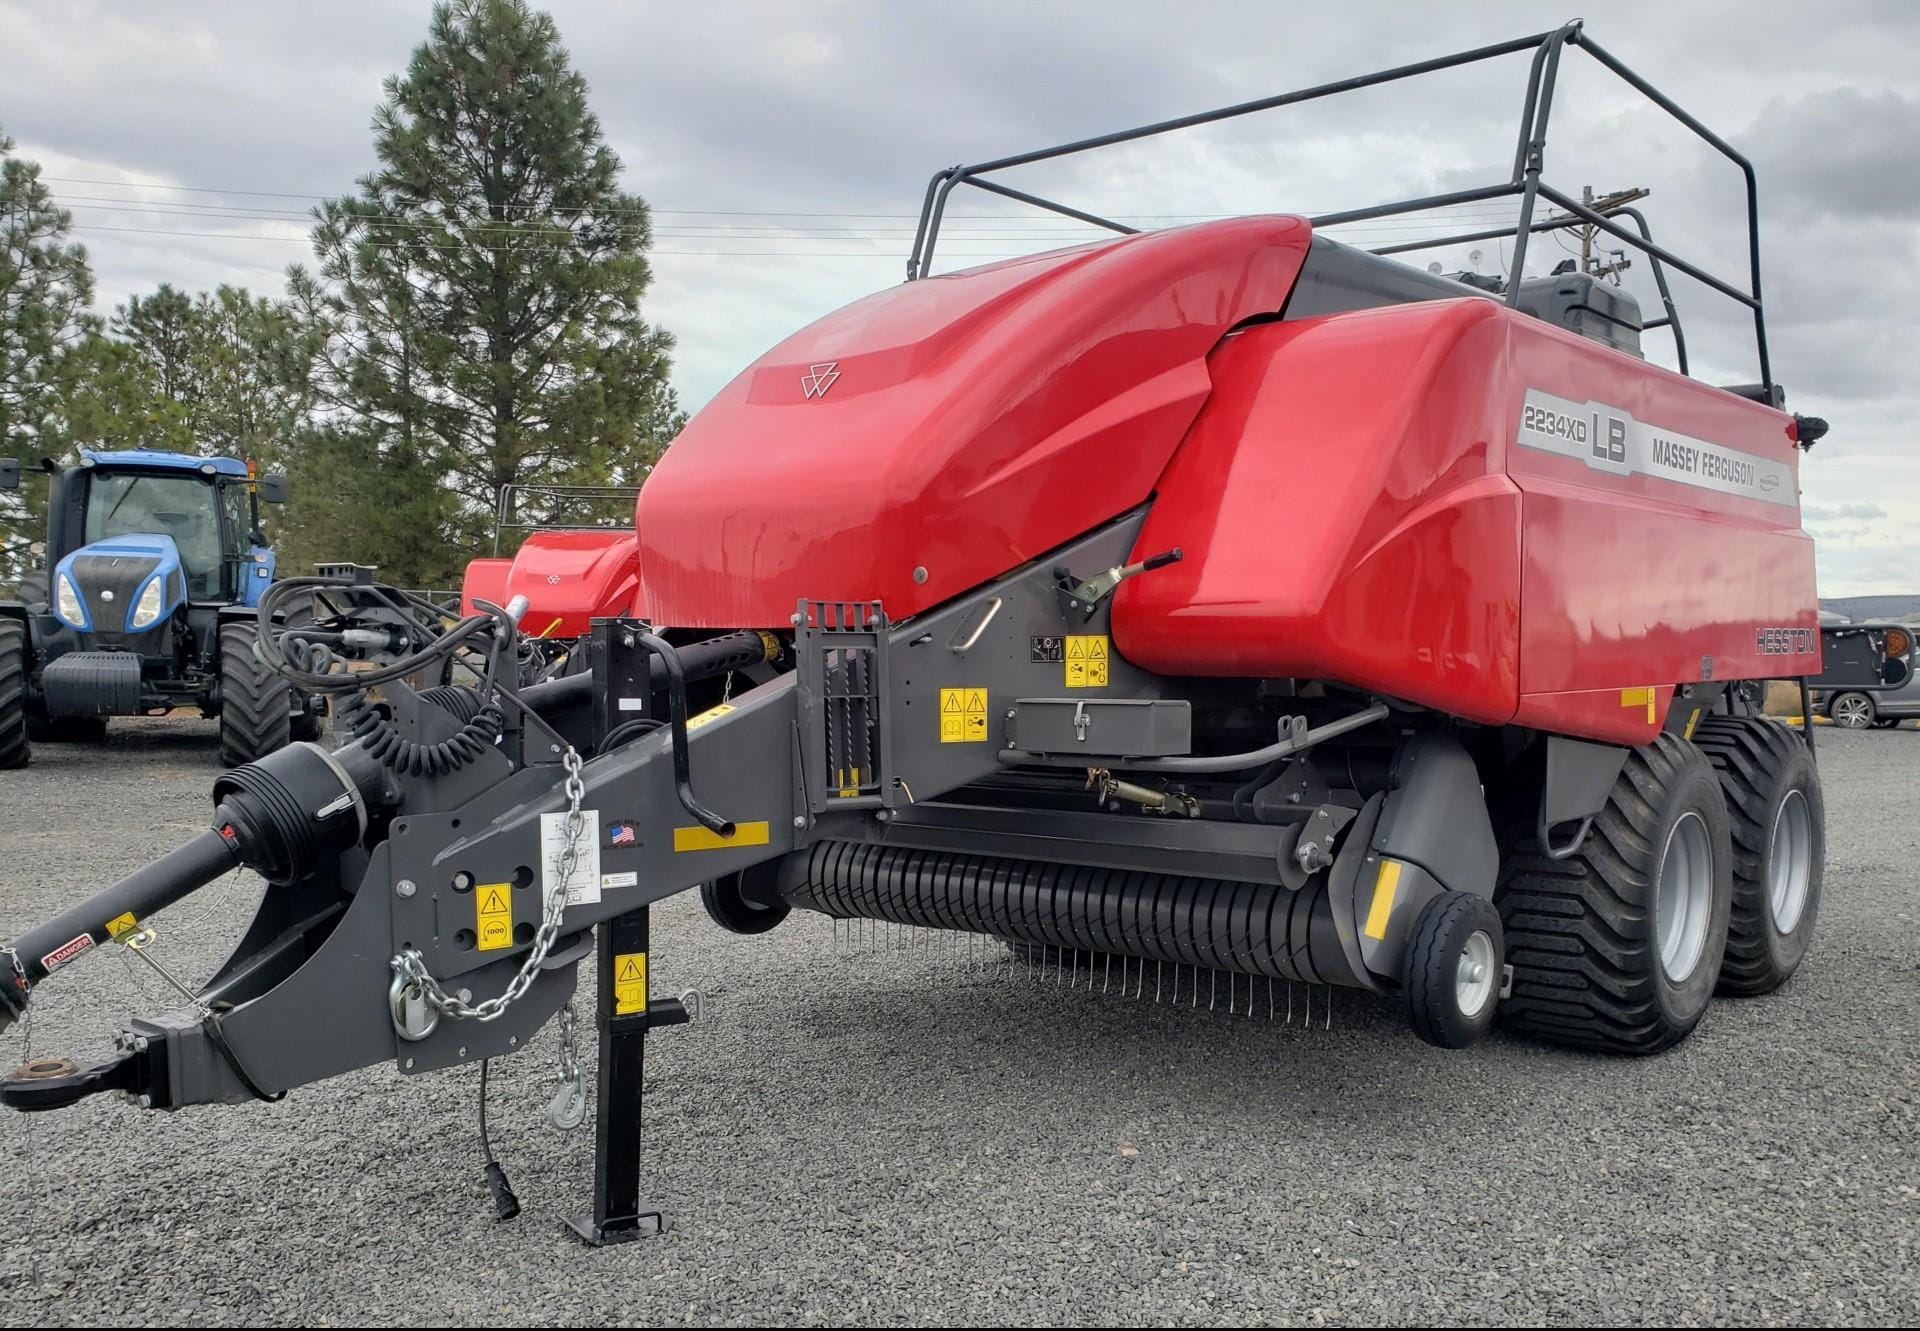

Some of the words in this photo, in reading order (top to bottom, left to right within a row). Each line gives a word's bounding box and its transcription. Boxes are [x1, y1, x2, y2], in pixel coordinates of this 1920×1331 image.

[1524, 405, 1586, 442] 2234XD
[1592, 412, 1626, 464] LB
[1652, 438, 1699, 473] MASSEY
[1702, 455, 1755, 487] FERGUSON
[1755, 628, 1815, 656] HESSTON
[486, 927, 504, 936] 1000
[56, 938, 90, 961] DANGER
